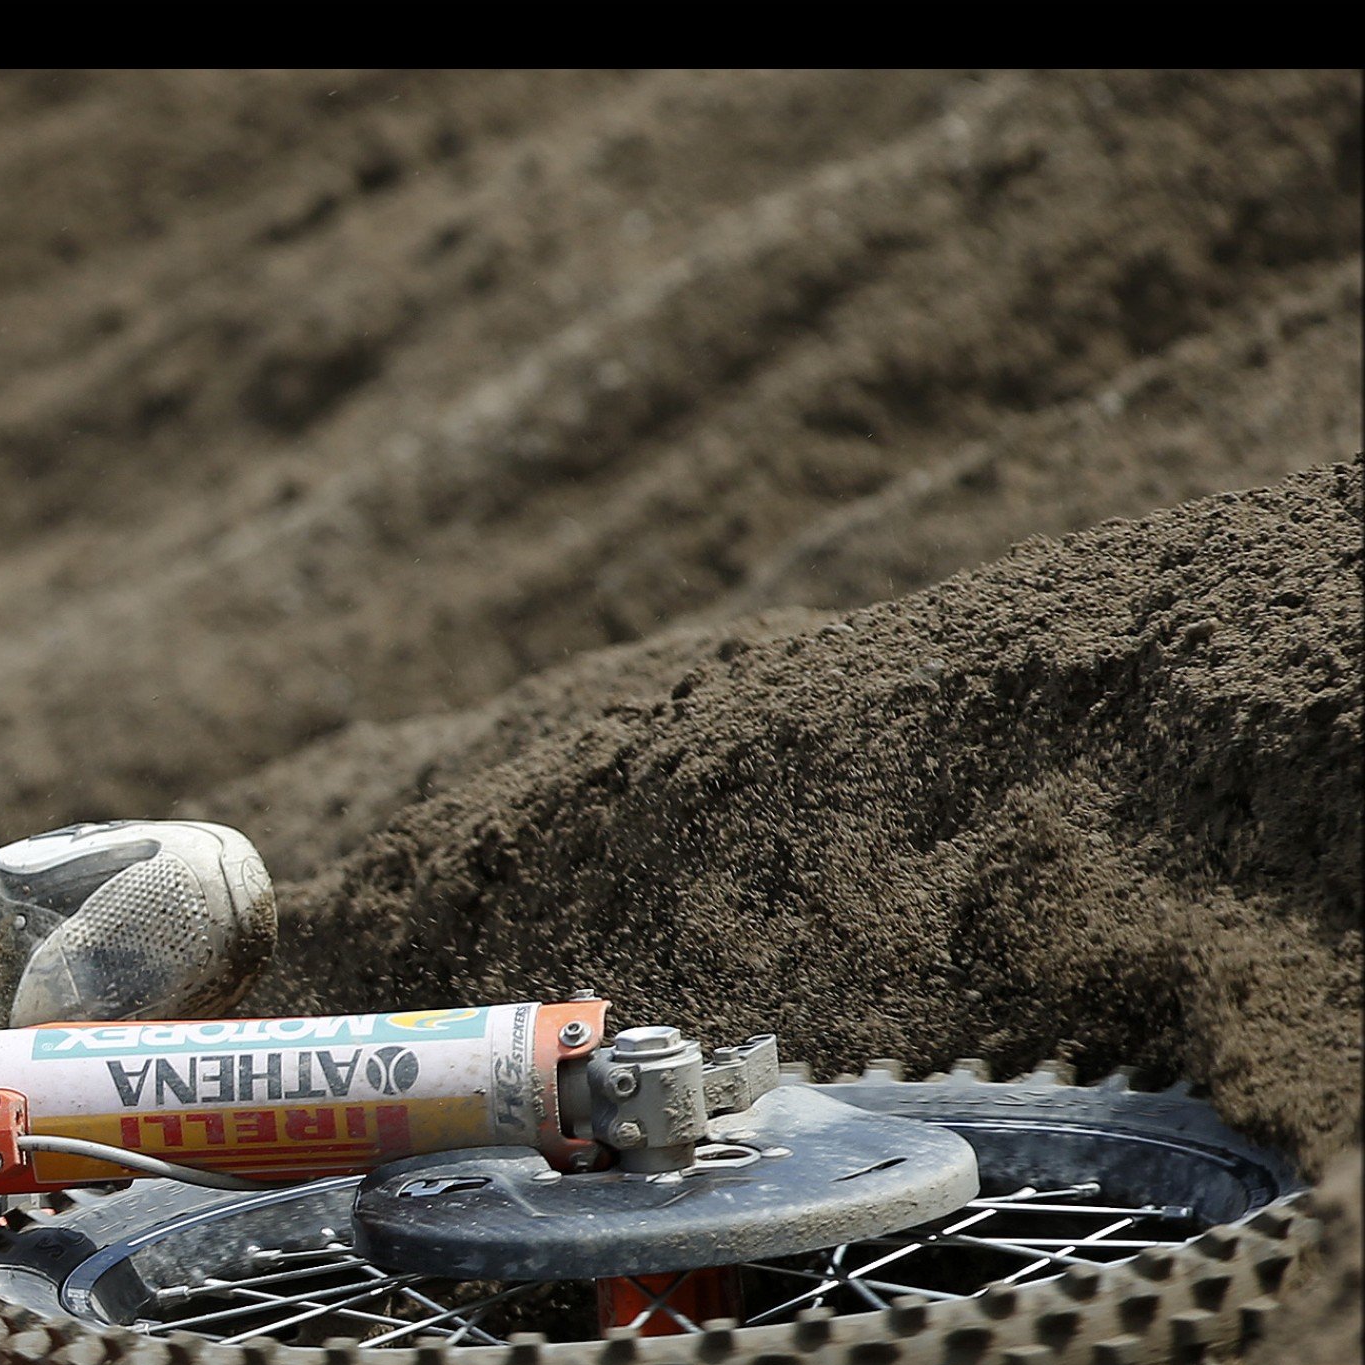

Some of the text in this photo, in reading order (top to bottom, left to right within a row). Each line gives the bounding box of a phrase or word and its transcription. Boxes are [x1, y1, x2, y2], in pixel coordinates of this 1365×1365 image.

[54, 1013, 373, 1048] MOTOREX
[106, 1046, 364, 1108] ATHENA
[120, 1104, 415, 1163] PIRELLI
